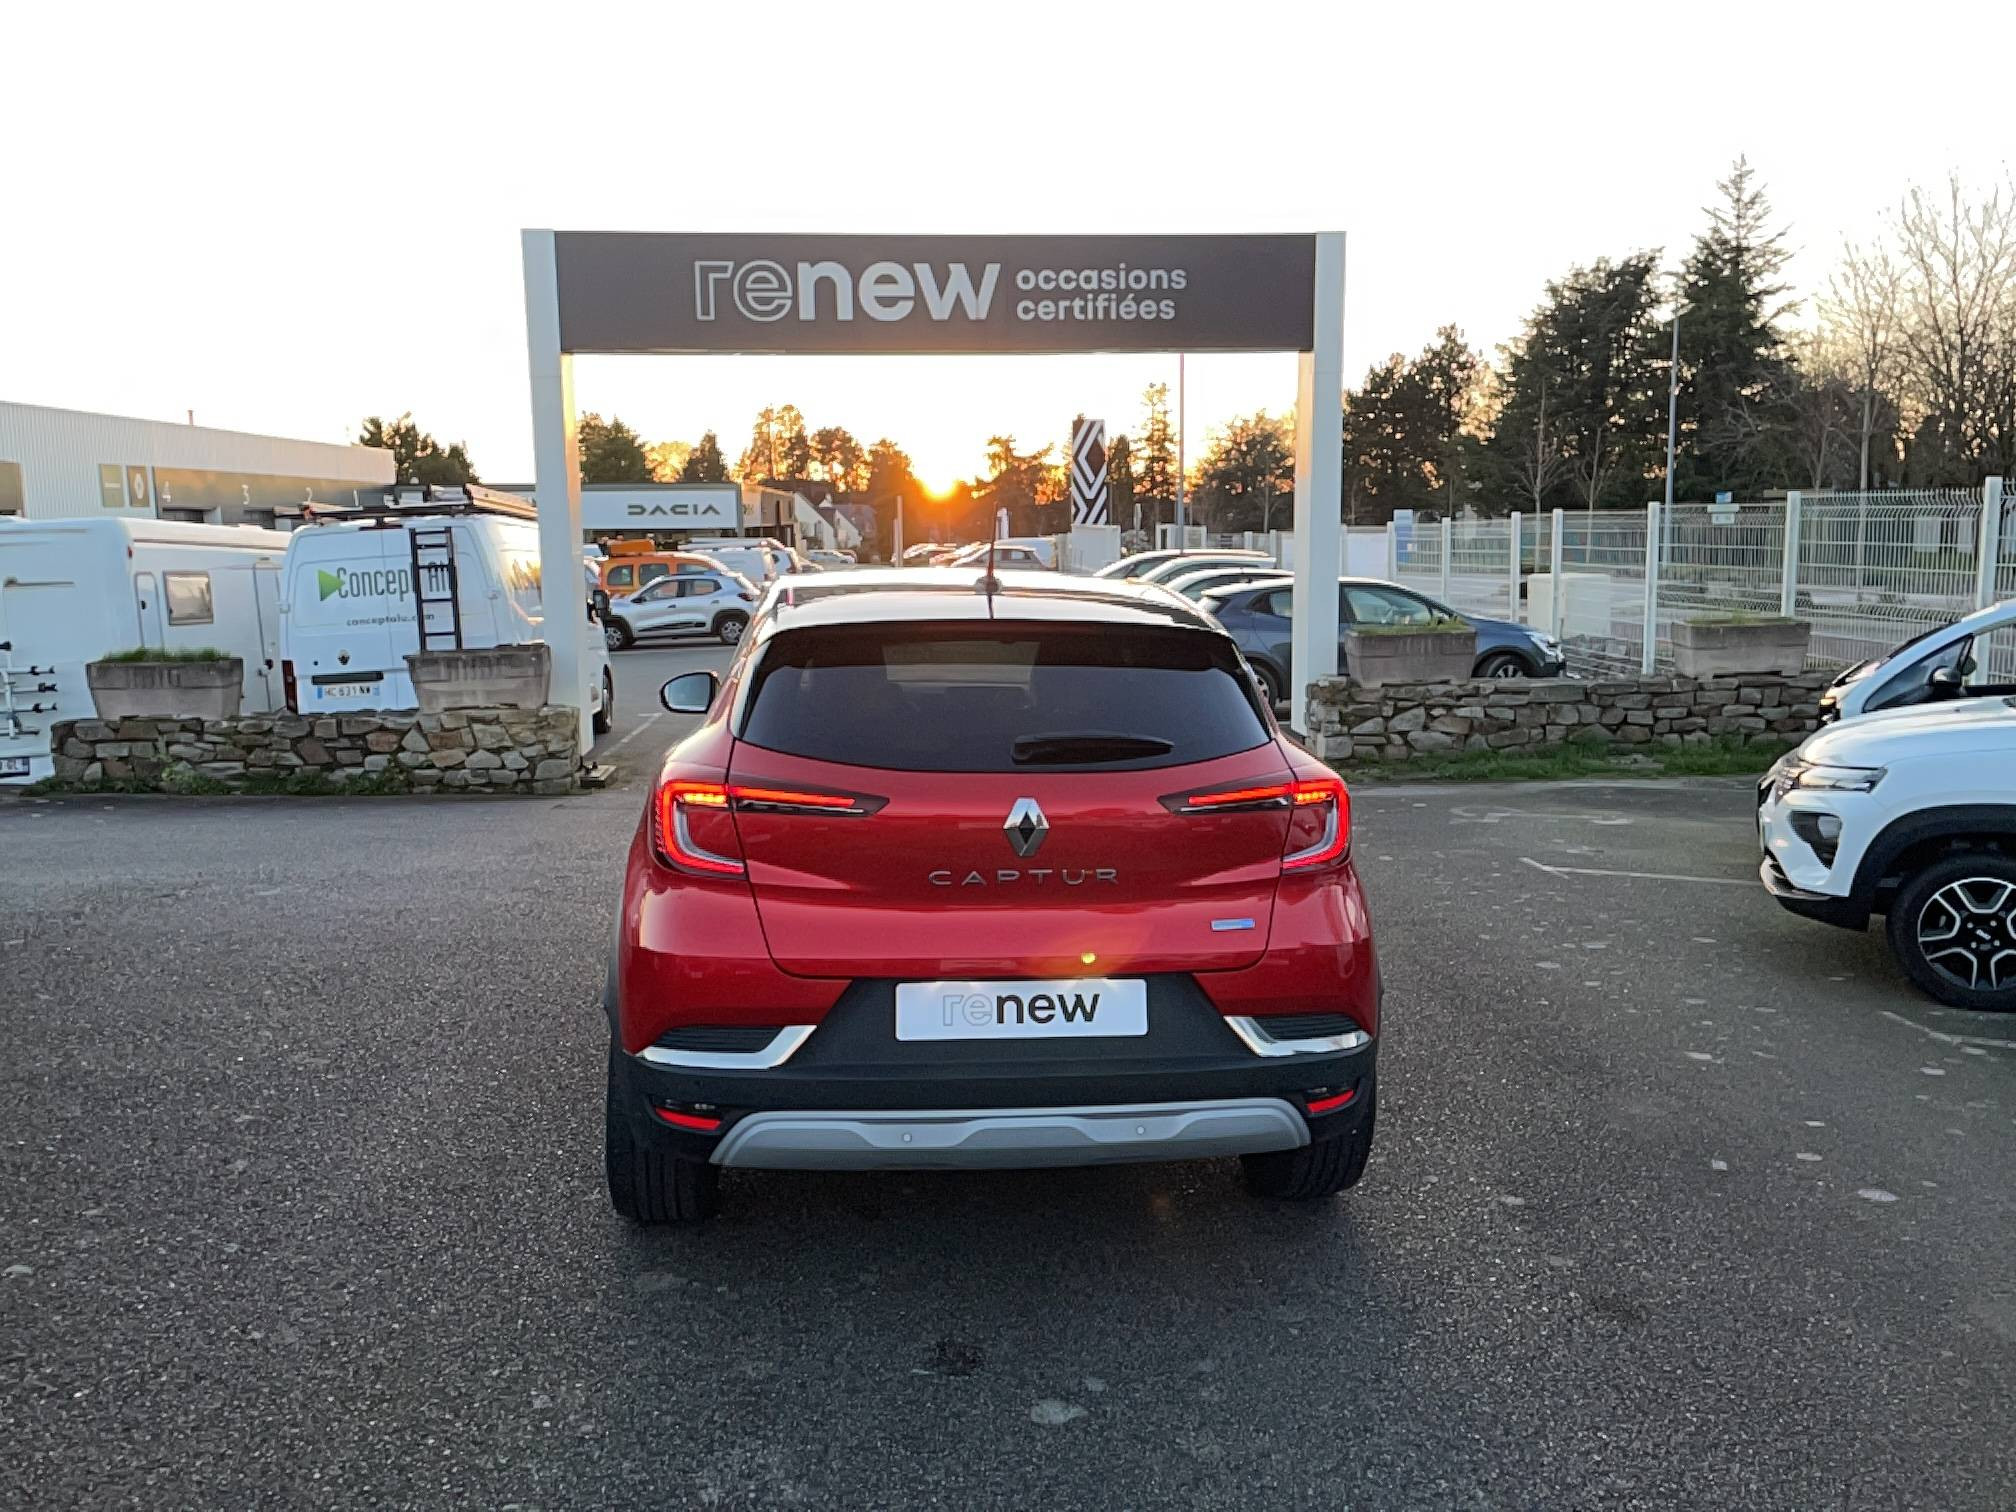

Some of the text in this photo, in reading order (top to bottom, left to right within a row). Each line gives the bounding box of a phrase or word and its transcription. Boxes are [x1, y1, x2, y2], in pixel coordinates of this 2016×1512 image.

[1016, 263, 1187, 290] occasions
[694, 261, 1001, 322] renew
[1016, 291, 1176, 321] certifiées
[162, 480, 172, 502] 4
[241, 484, 250, 505] 3
[627, 504, 721, 516] DACIA
[930, 868, 1119, 886] CAPTUR
[942, 992, 1100, 1027] renew
